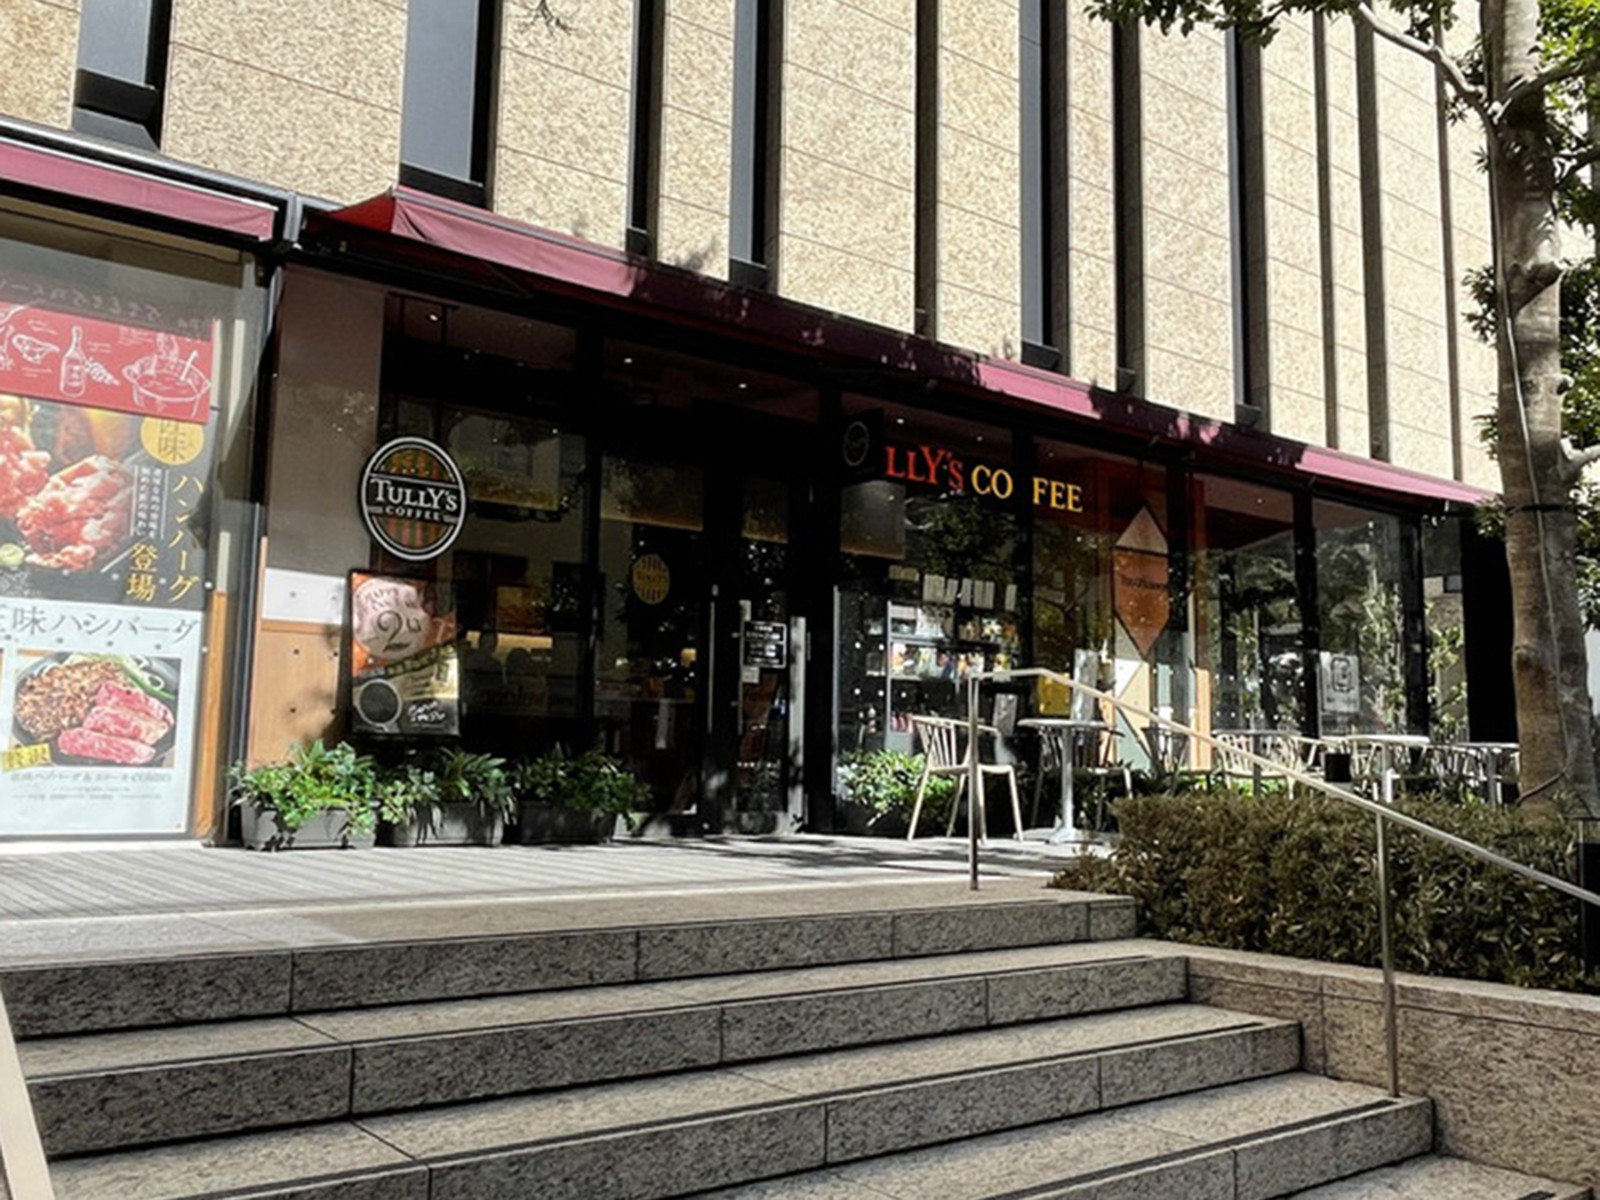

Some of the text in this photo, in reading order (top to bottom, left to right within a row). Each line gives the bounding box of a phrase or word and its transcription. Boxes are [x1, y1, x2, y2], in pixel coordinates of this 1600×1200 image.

[885, 446, 1083, 512] LLY'S COFEE
[385, 505, 440, 521] COFFEE
[126, 543, 159, 602] 登場
